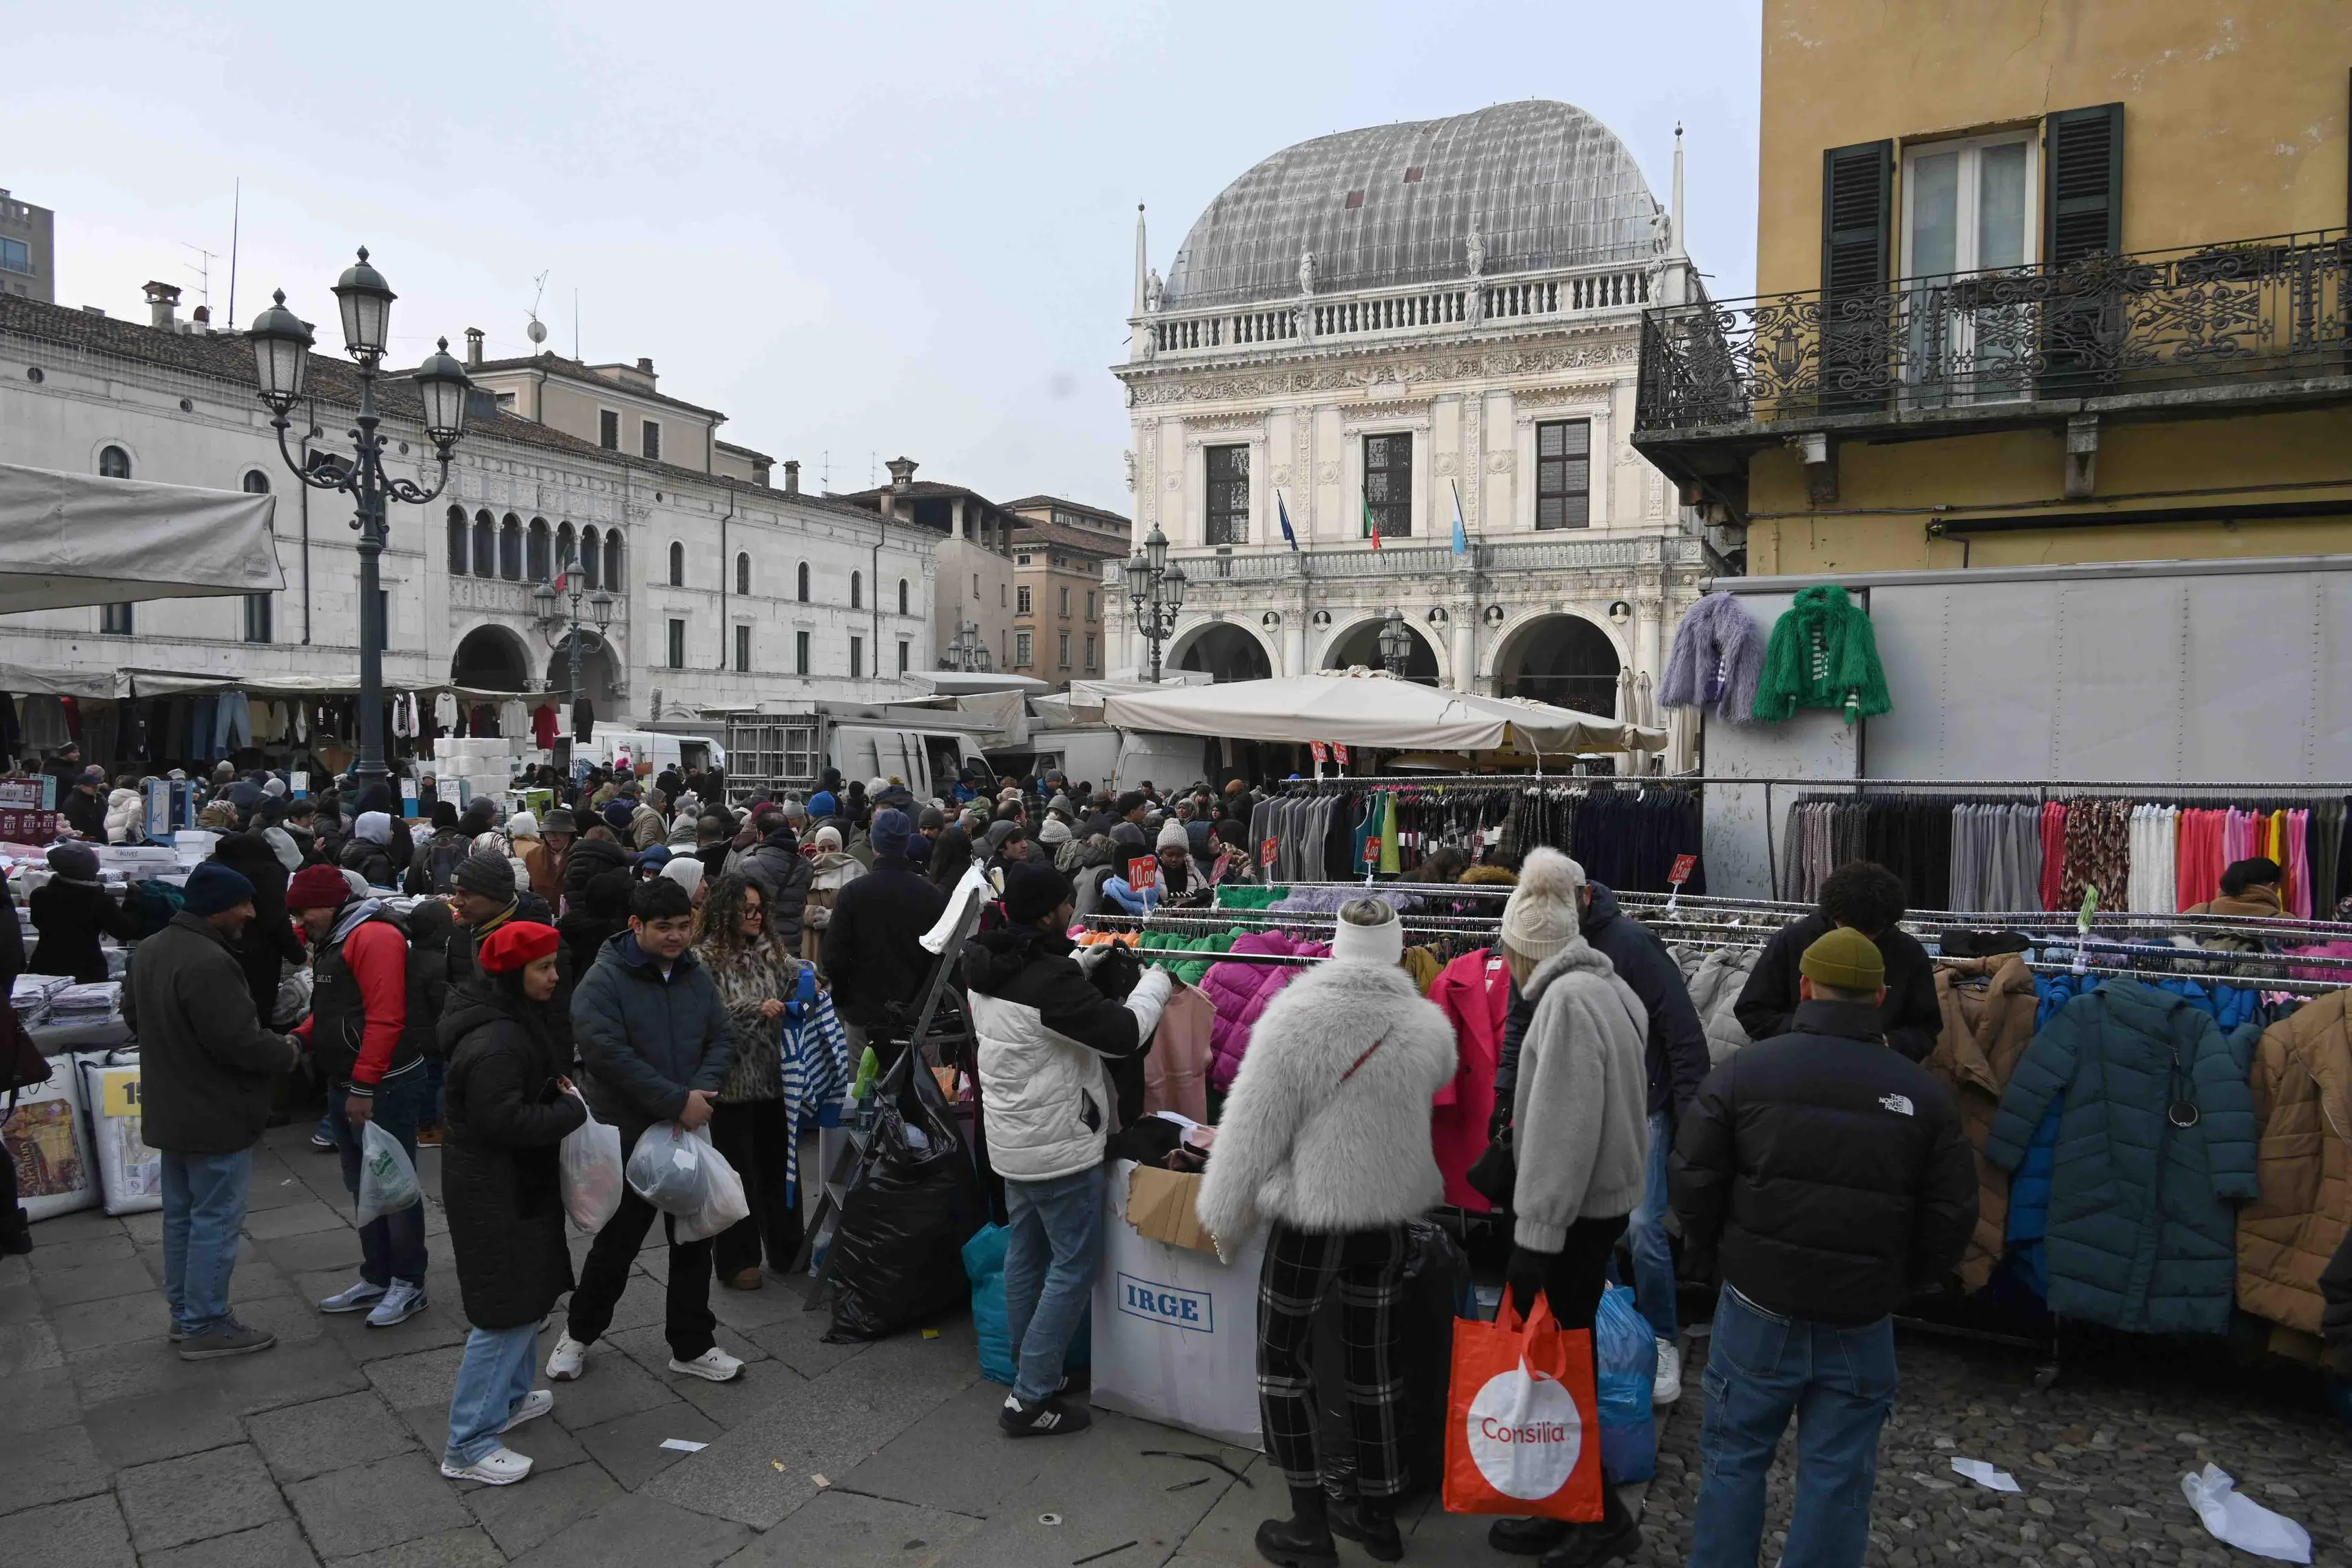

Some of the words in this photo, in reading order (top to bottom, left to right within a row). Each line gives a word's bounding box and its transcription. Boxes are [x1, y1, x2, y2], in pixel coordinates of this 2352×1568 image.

[1312, 743, 1327, 759] 4,00
[1334, 745, 1348, 761] 4,00
[1262, 845, 1277, 863] 15,00
[1365, 840, 1379, 858] 4,00
[1131, 864, 1155, 887] 10,00
[1671, 860, 1691, 879] 15,00
[1878, 1096, 1903, 1107] NORTH
[1890, 1093, 1903, 1102] THE
[1884, 1103, 1903, 1113] FACE
[1127, 1283, 1199, 1322] IRGE
[1482, 1416, 1566, 1444] Consilia
